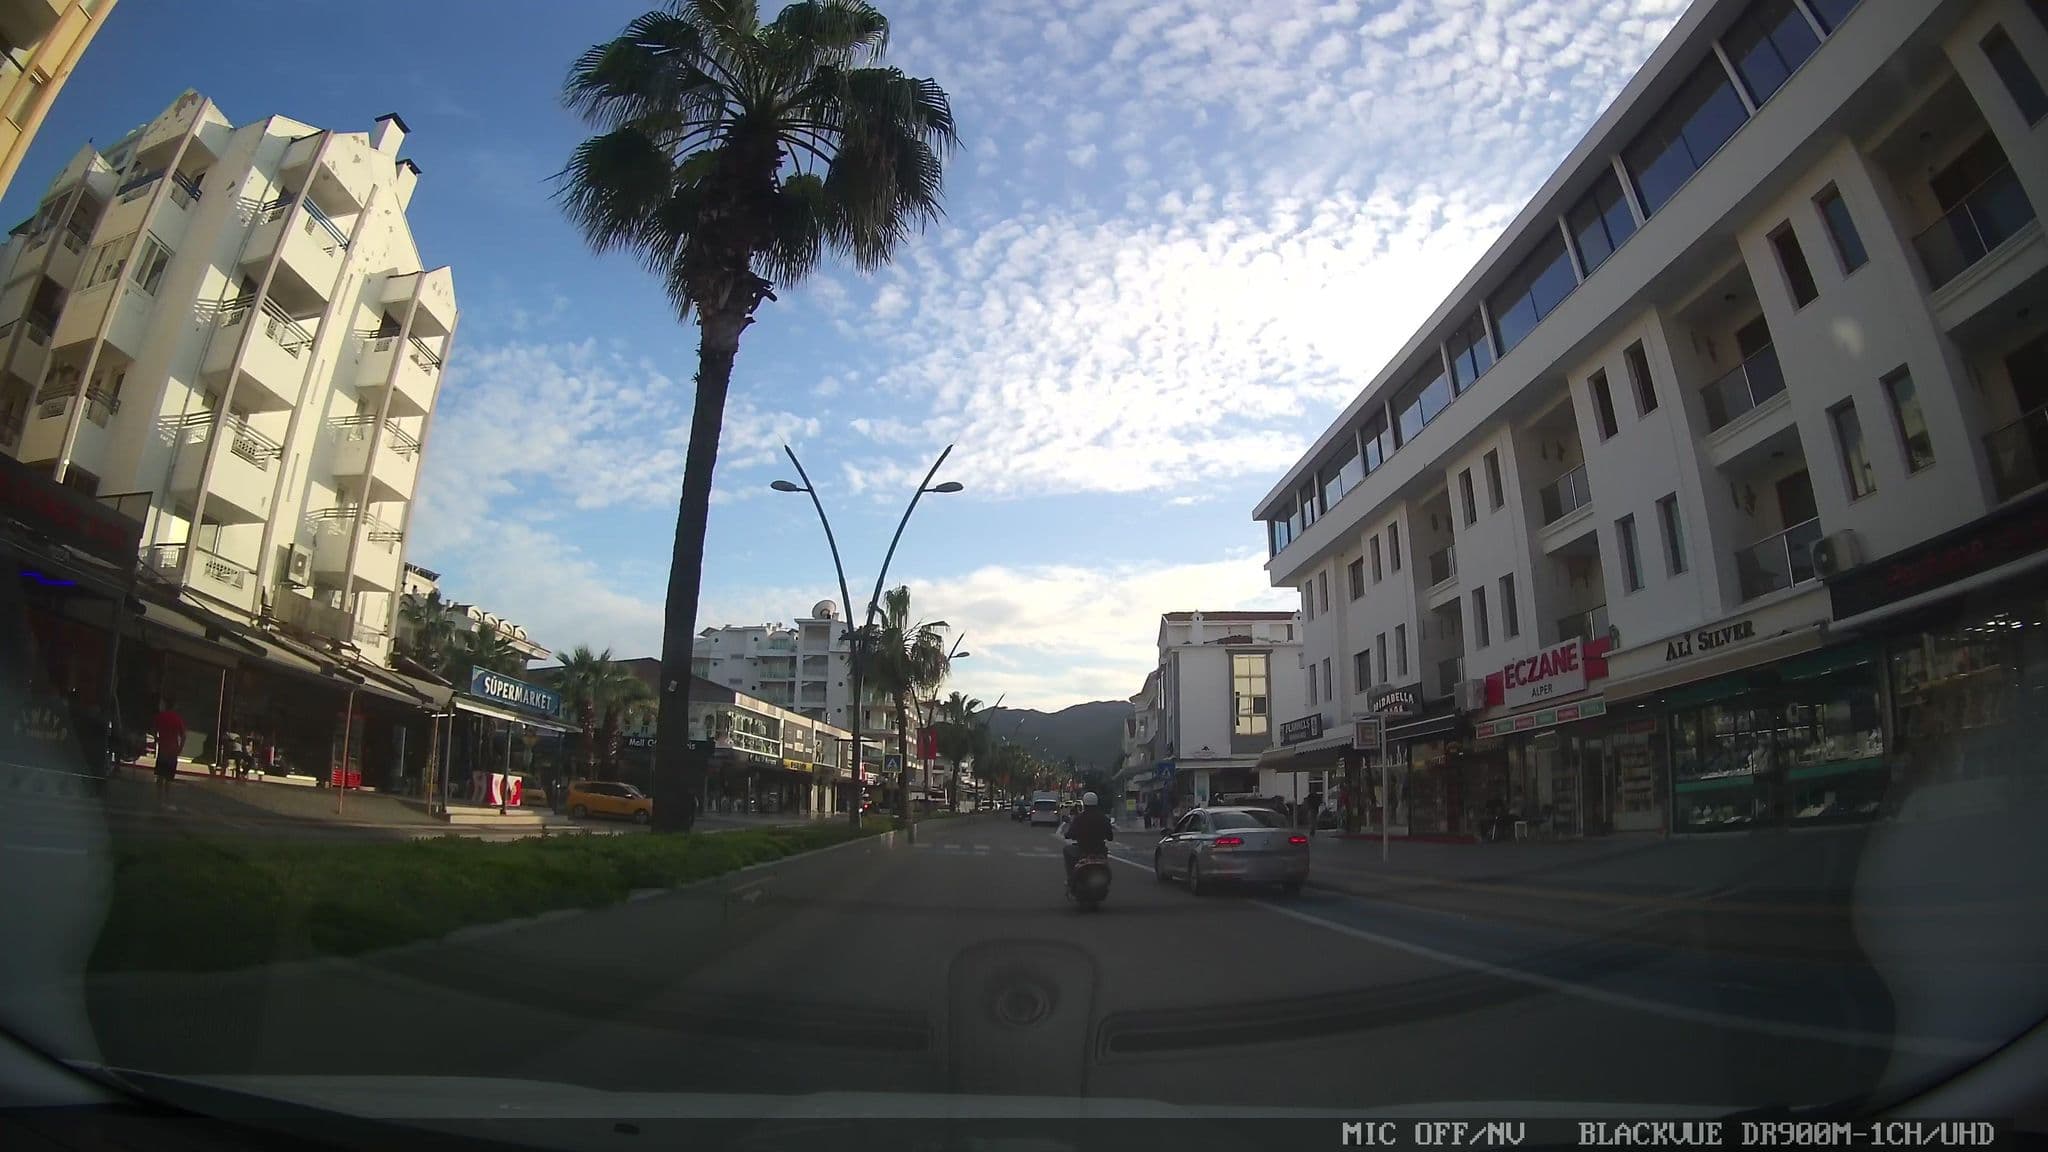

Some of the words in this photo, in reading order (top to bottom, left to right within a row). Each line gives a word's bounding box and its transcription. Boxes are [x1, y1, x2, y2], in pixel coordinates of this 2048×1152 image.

[1504, 642, 1579, 689] ECZANE
[484, 675, 552, 711] SÜPERMARKET
[1531, 683, 1553, 698] ALPER
[1373, 691, 1414, 713] MIRABELLA
[628, 737, 645, 748] Mall
